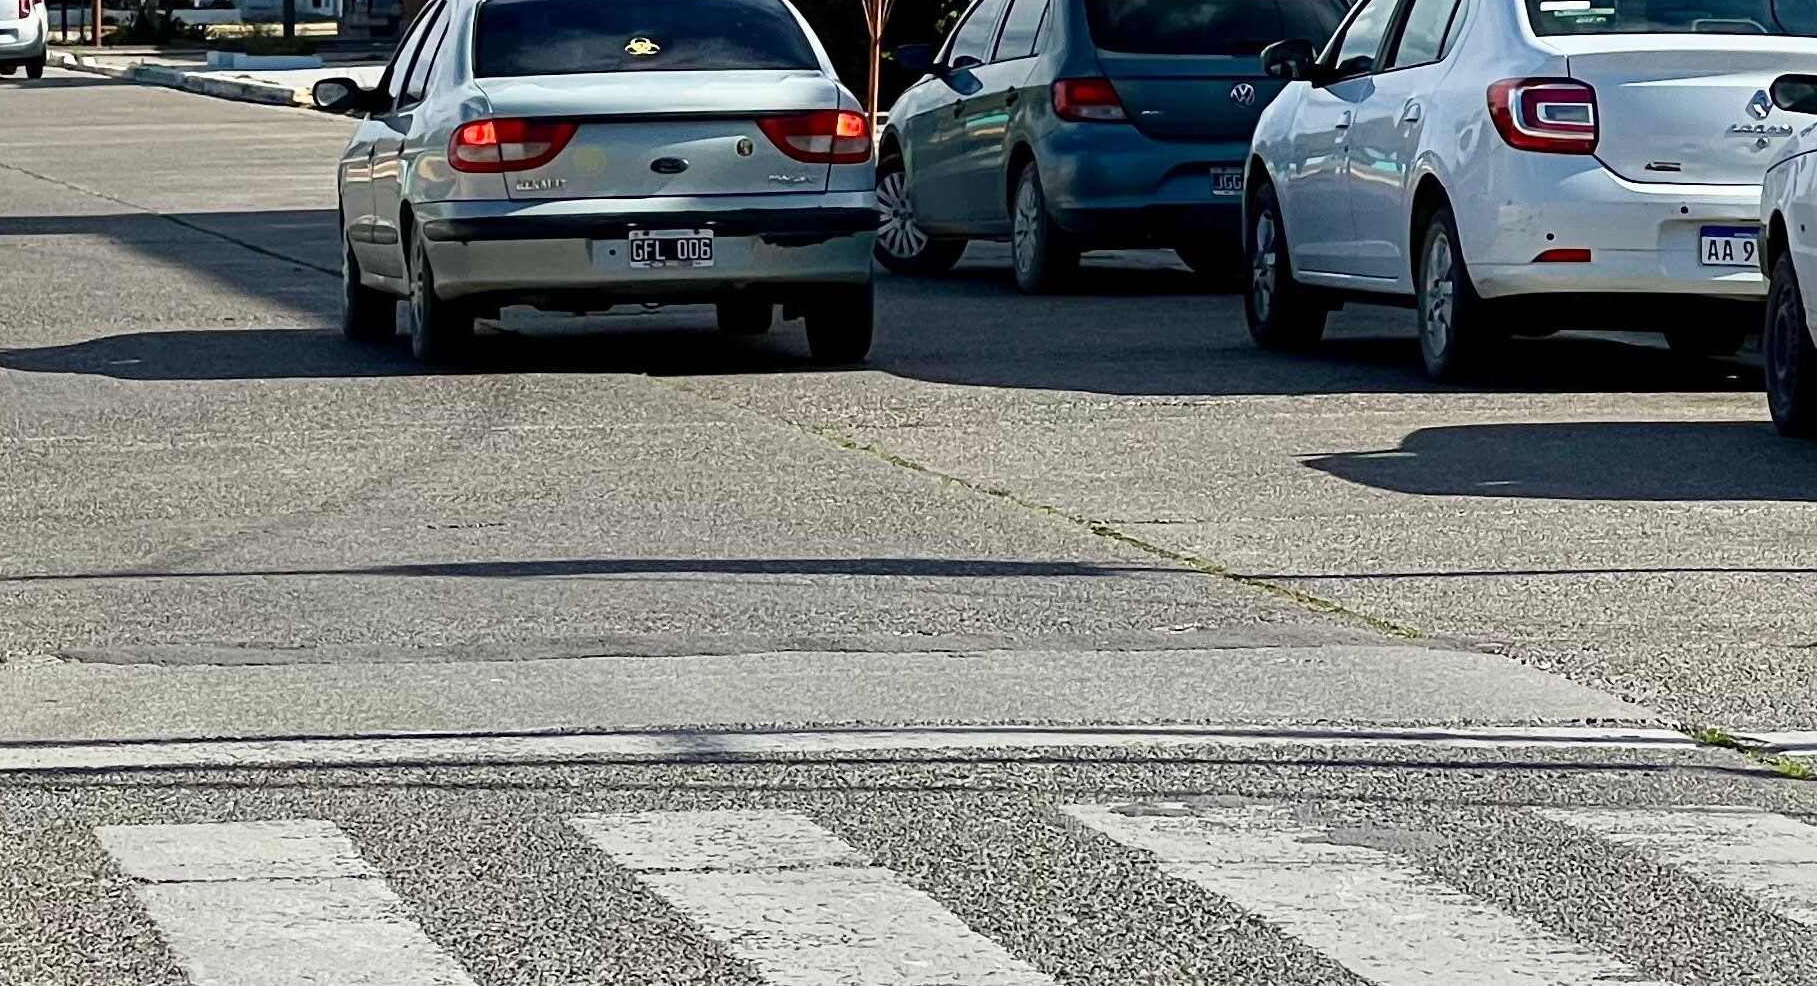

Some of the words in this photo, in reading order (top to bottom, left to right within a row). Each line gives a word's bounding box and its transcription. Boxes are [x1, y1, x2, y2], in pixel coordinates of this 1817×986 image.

[1214, 174, 1242, 190] JGG
[632, 240, 666, 261] GFL
[677, 239, 711, 260] 006
[1707, 239, 1734, 261] AA
